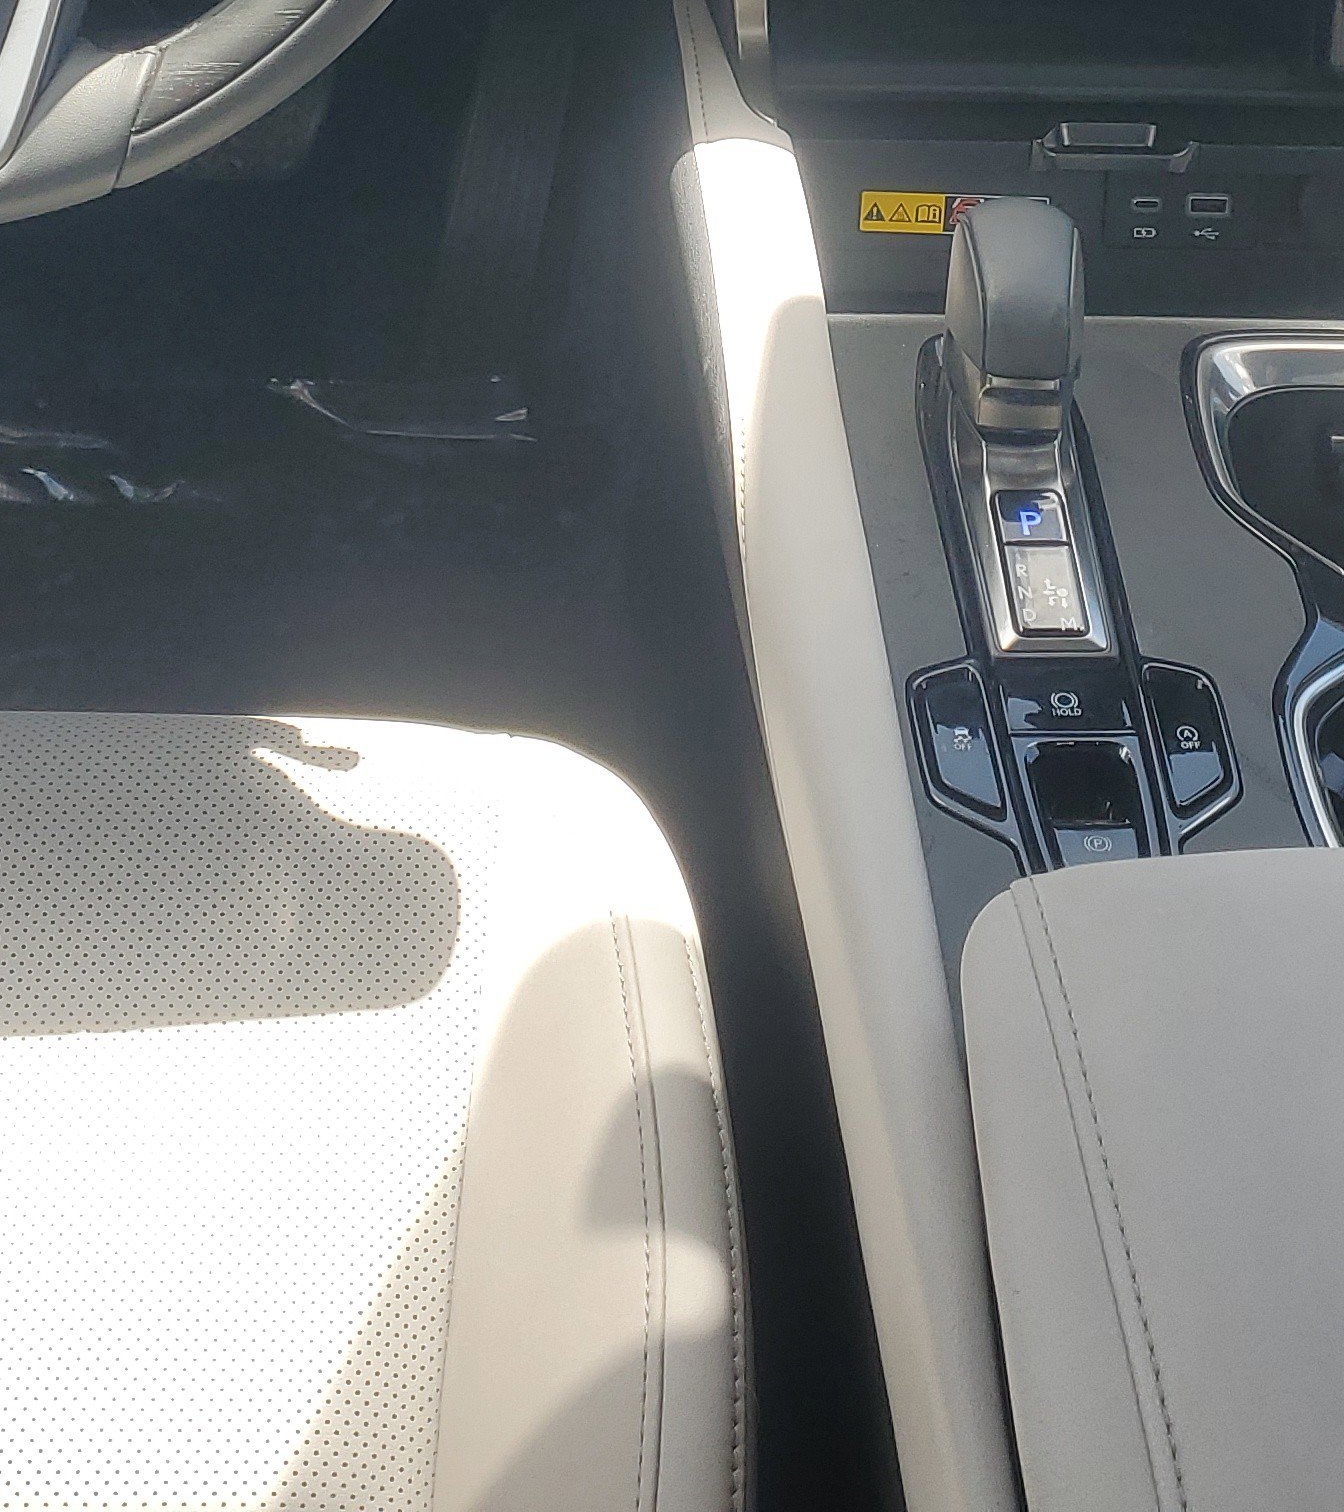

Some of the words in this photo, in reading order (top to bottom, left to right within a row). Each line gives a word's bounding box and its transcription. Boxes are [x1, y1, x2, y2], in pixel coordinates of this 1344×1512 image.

[1019, 511, 1042, 536] P
[1016, 564, 1028, 578] R
[1018, 586, 1033, 600] N
[1022, 609, 1037, 623] D
[1061, 618, 1079, 631] M
[1053, 706, 1083, 717] HOLD
[1180, 740, 1201, 750] OFF
